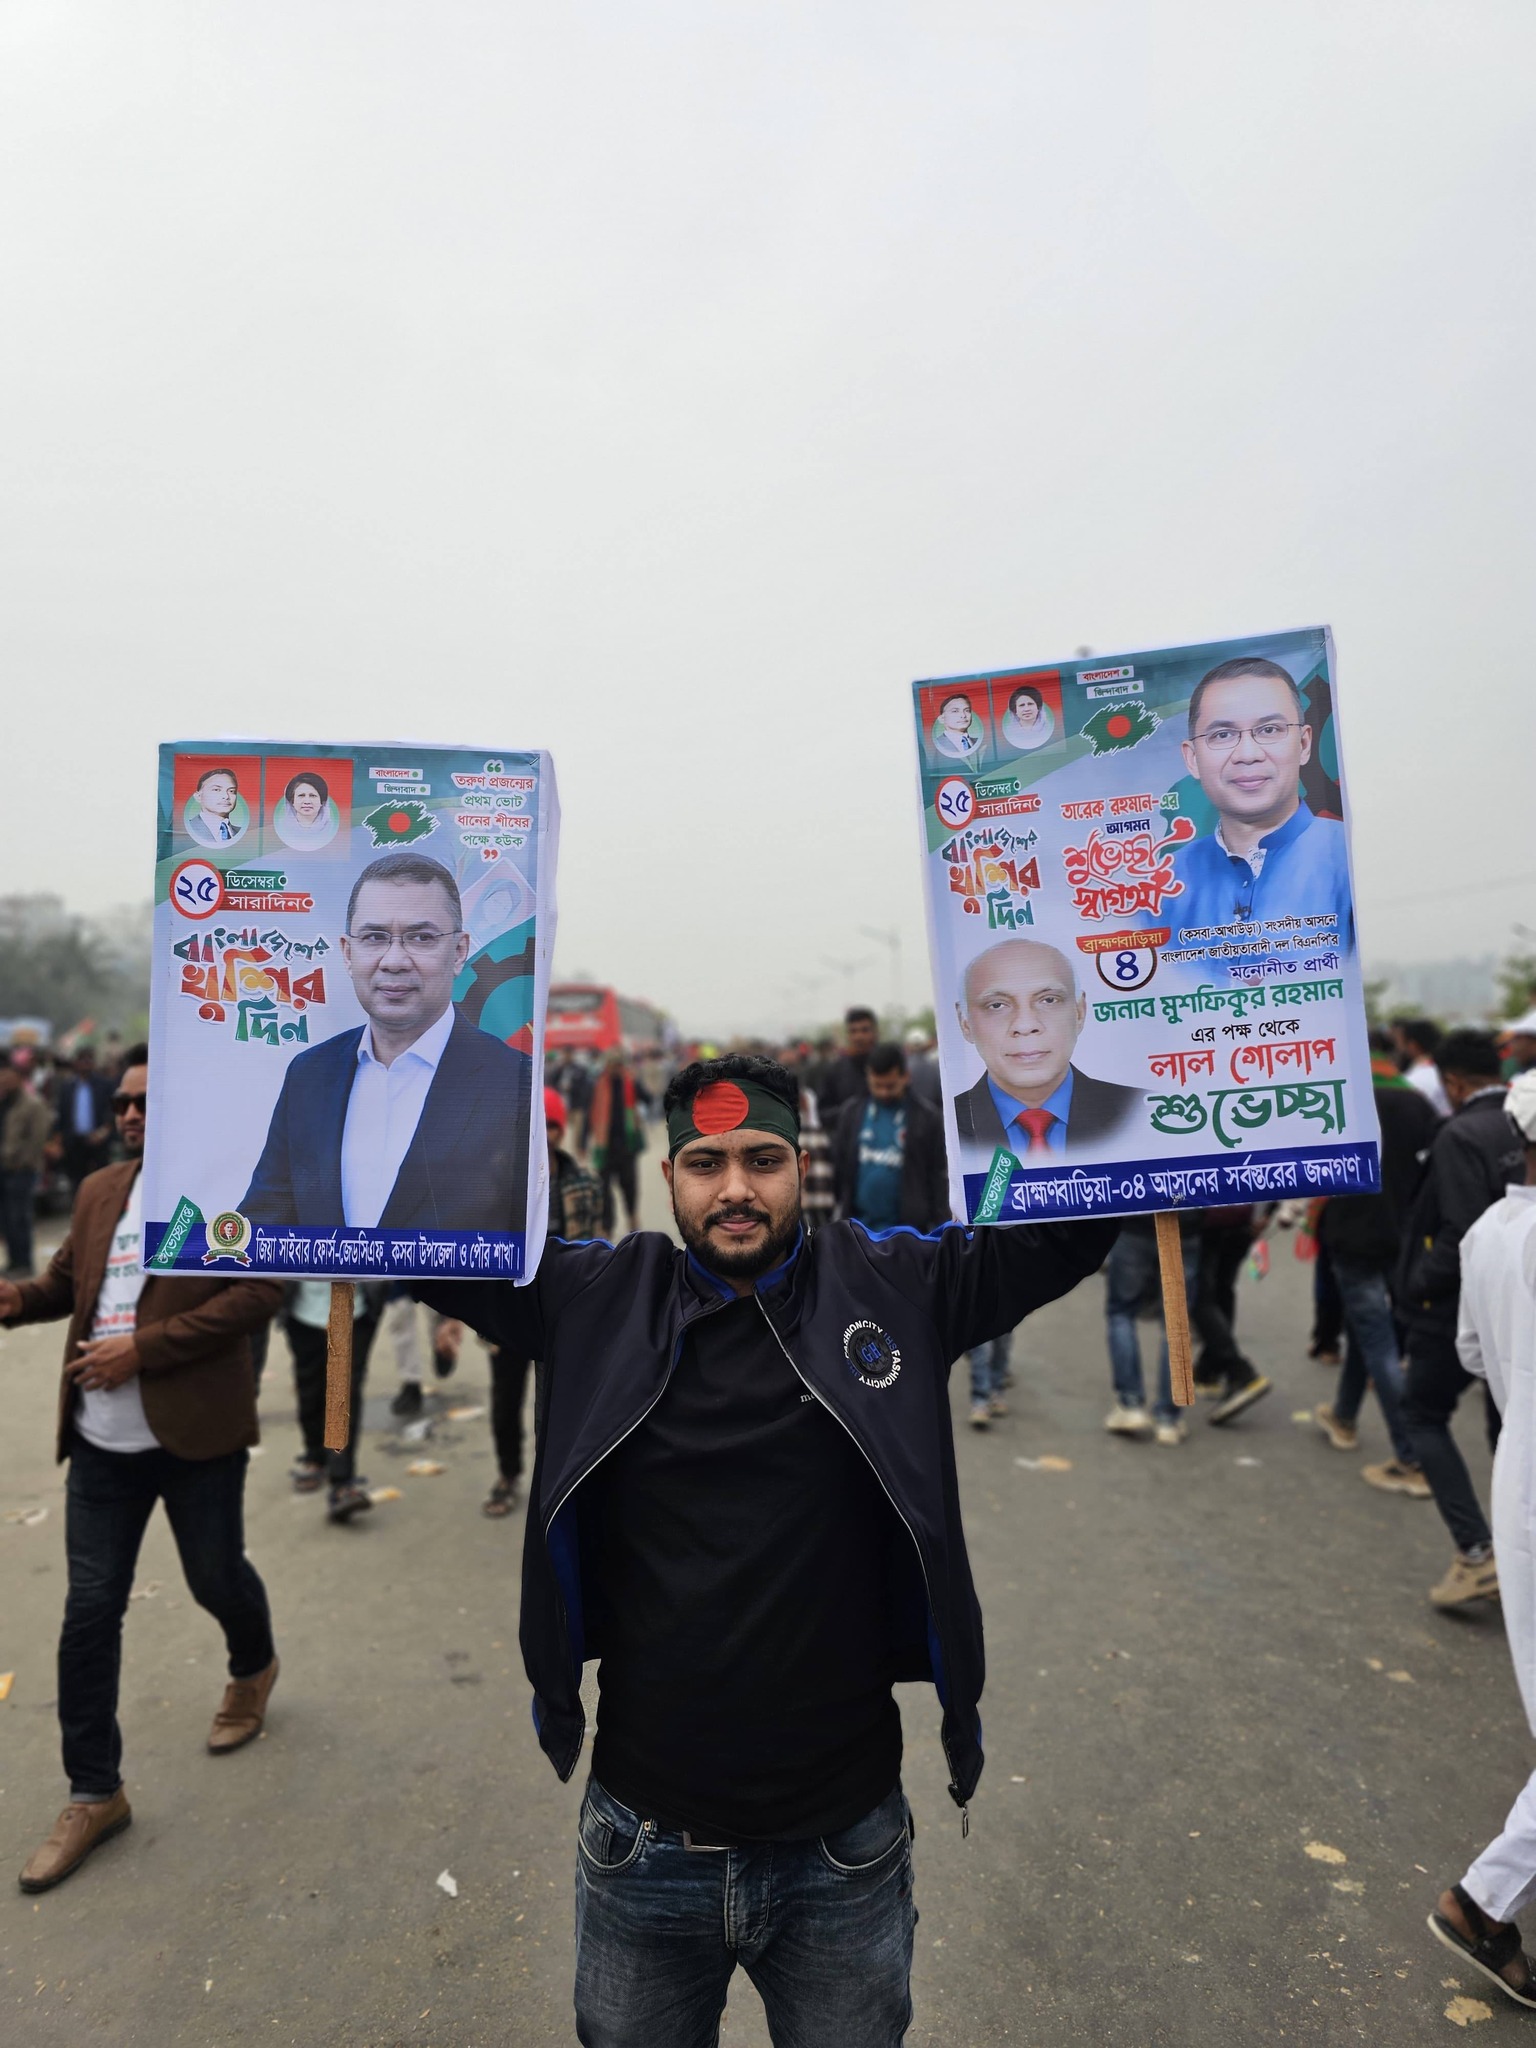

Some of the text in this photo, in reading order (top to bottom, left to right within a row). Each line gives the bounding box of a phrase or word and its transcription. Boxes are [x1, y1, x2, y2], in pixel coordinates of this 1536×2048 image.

[1082, 668, 1120, 682] বাংলাদেশ
[1093, 684, 1130, 698] জিন্দাবাদ
[375, 768, 410, 779] বাংলাদেশ
[455, 775, 534, 791] তরুণ প্রজন্মের
[383, 783, 417, 794] জিন্দাবাদ
[464, 795, 524, 808] প্রথম ভোট
[974, 782, 1012, 799] ডিসেম্বর
[940, 790, 971, 817] ২৫
[977, 798, 1033, 817] সারাদিন
[1060, 793, 1179, 820] তারেক রহমান-এর
[457, 813, 530, 828] ধানের শীষের
[1105, 818, 1151, 834] আগমন
[463, 833, 524, 847] পক্ষে হউক
[942, 827, 1038, 864] বাংলাদেশের
[1063, 820, 1193, 885] শুভেচ্ছা
[176, 875, 218, 906] ২৫
[225, 870, 276, 889] ডিসেম্বর
[949, 843, 1041, 914] খুশির
[228, 893, 300, 911] সারাদিন
[986, 886, 1035, 931] দিন
[1082, 930, 1164, 953] ব্রাহ্মণবাড়িয়া
[1178, 914, 1336, 945] (কসবা-আখাউড়া) সংসদীয় আসনে
[173, 927, 331, 963] বাংলাদেশের
[1160, 947, 1206, 963] বাংলাদেশ
[1208, 940, 1271, 959] জাতীয়তাবাদী
[1274, 940, 1290, 952] দল
[1115, 951, 1140, 981] ৪
[1229, 951, 1340, 980] মনোনীত প্রার্থী
[180, 945, 327, 1022] খুশির
[1092, 978, 1344, 1025] জনাব মুশফিকুর রহমান
[234, 995, 309, 1046] দিন
[1190, 1018, 1300, 1044] এর পক্ষ থেকে
[1147, 1037, 1336, 1087] লাল গোলাপ
[1147, 1078, 1348, 1149] শুভেচ্ছা
[1011, 1168, 1146, 1213] ব্রাহ্মণবাড়িয়া-০৪
[1148, 1167, 1220, 1198] আসনের
[1223, 1154, 1298, 1192] সর্বস্তরের
[1301, 1152, 1361, 1187] জনগণ
[255, 1227, 277, 1264] জিয়া
[279, 1228, 311, 1266] সাইবার
[391, 1239, 417, 1268] কসবা
[418, 1231, 457, 1269] উপজেলা
[459, 1243, 467, 1267] ও
[469, 1232, 492, 1270] পৌর
[858, 1349, 902, 1389] FASHIONCITY
